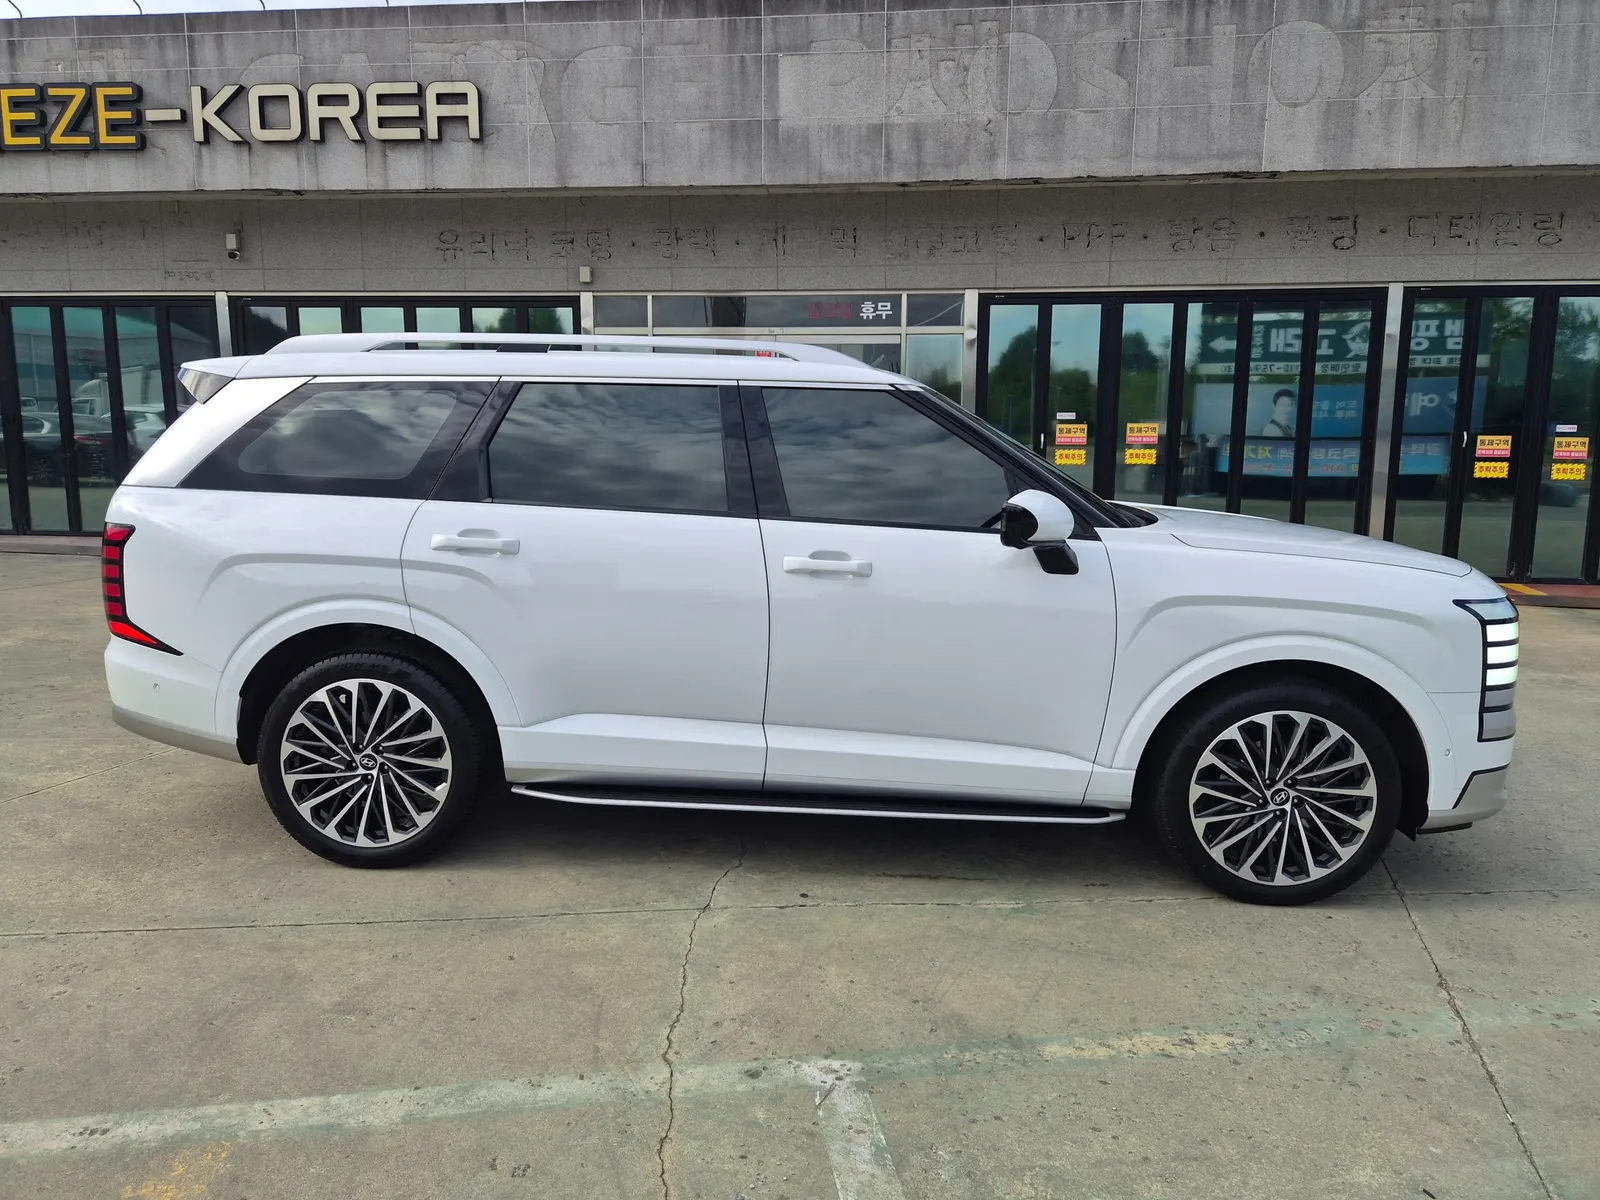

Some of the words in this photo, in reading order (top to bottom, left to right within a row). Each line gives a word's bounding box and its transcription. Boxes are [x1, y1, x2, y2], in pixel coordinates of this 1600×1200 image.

[0, 81, 483, 150] EZE-KOREA
[859, 301, 893, 320] 휴무
[1058, 427, 1085, 435] 통제구역
[1129, 426, 1157, 434] 통제구역
[1556, 440, 1587, 448] 통제구역
[1128, 452, 1153, 460] 추락주의
[1478, 465, 1505, 473] 추락주의
[1555, 467, 1582, 475] 추락주의
